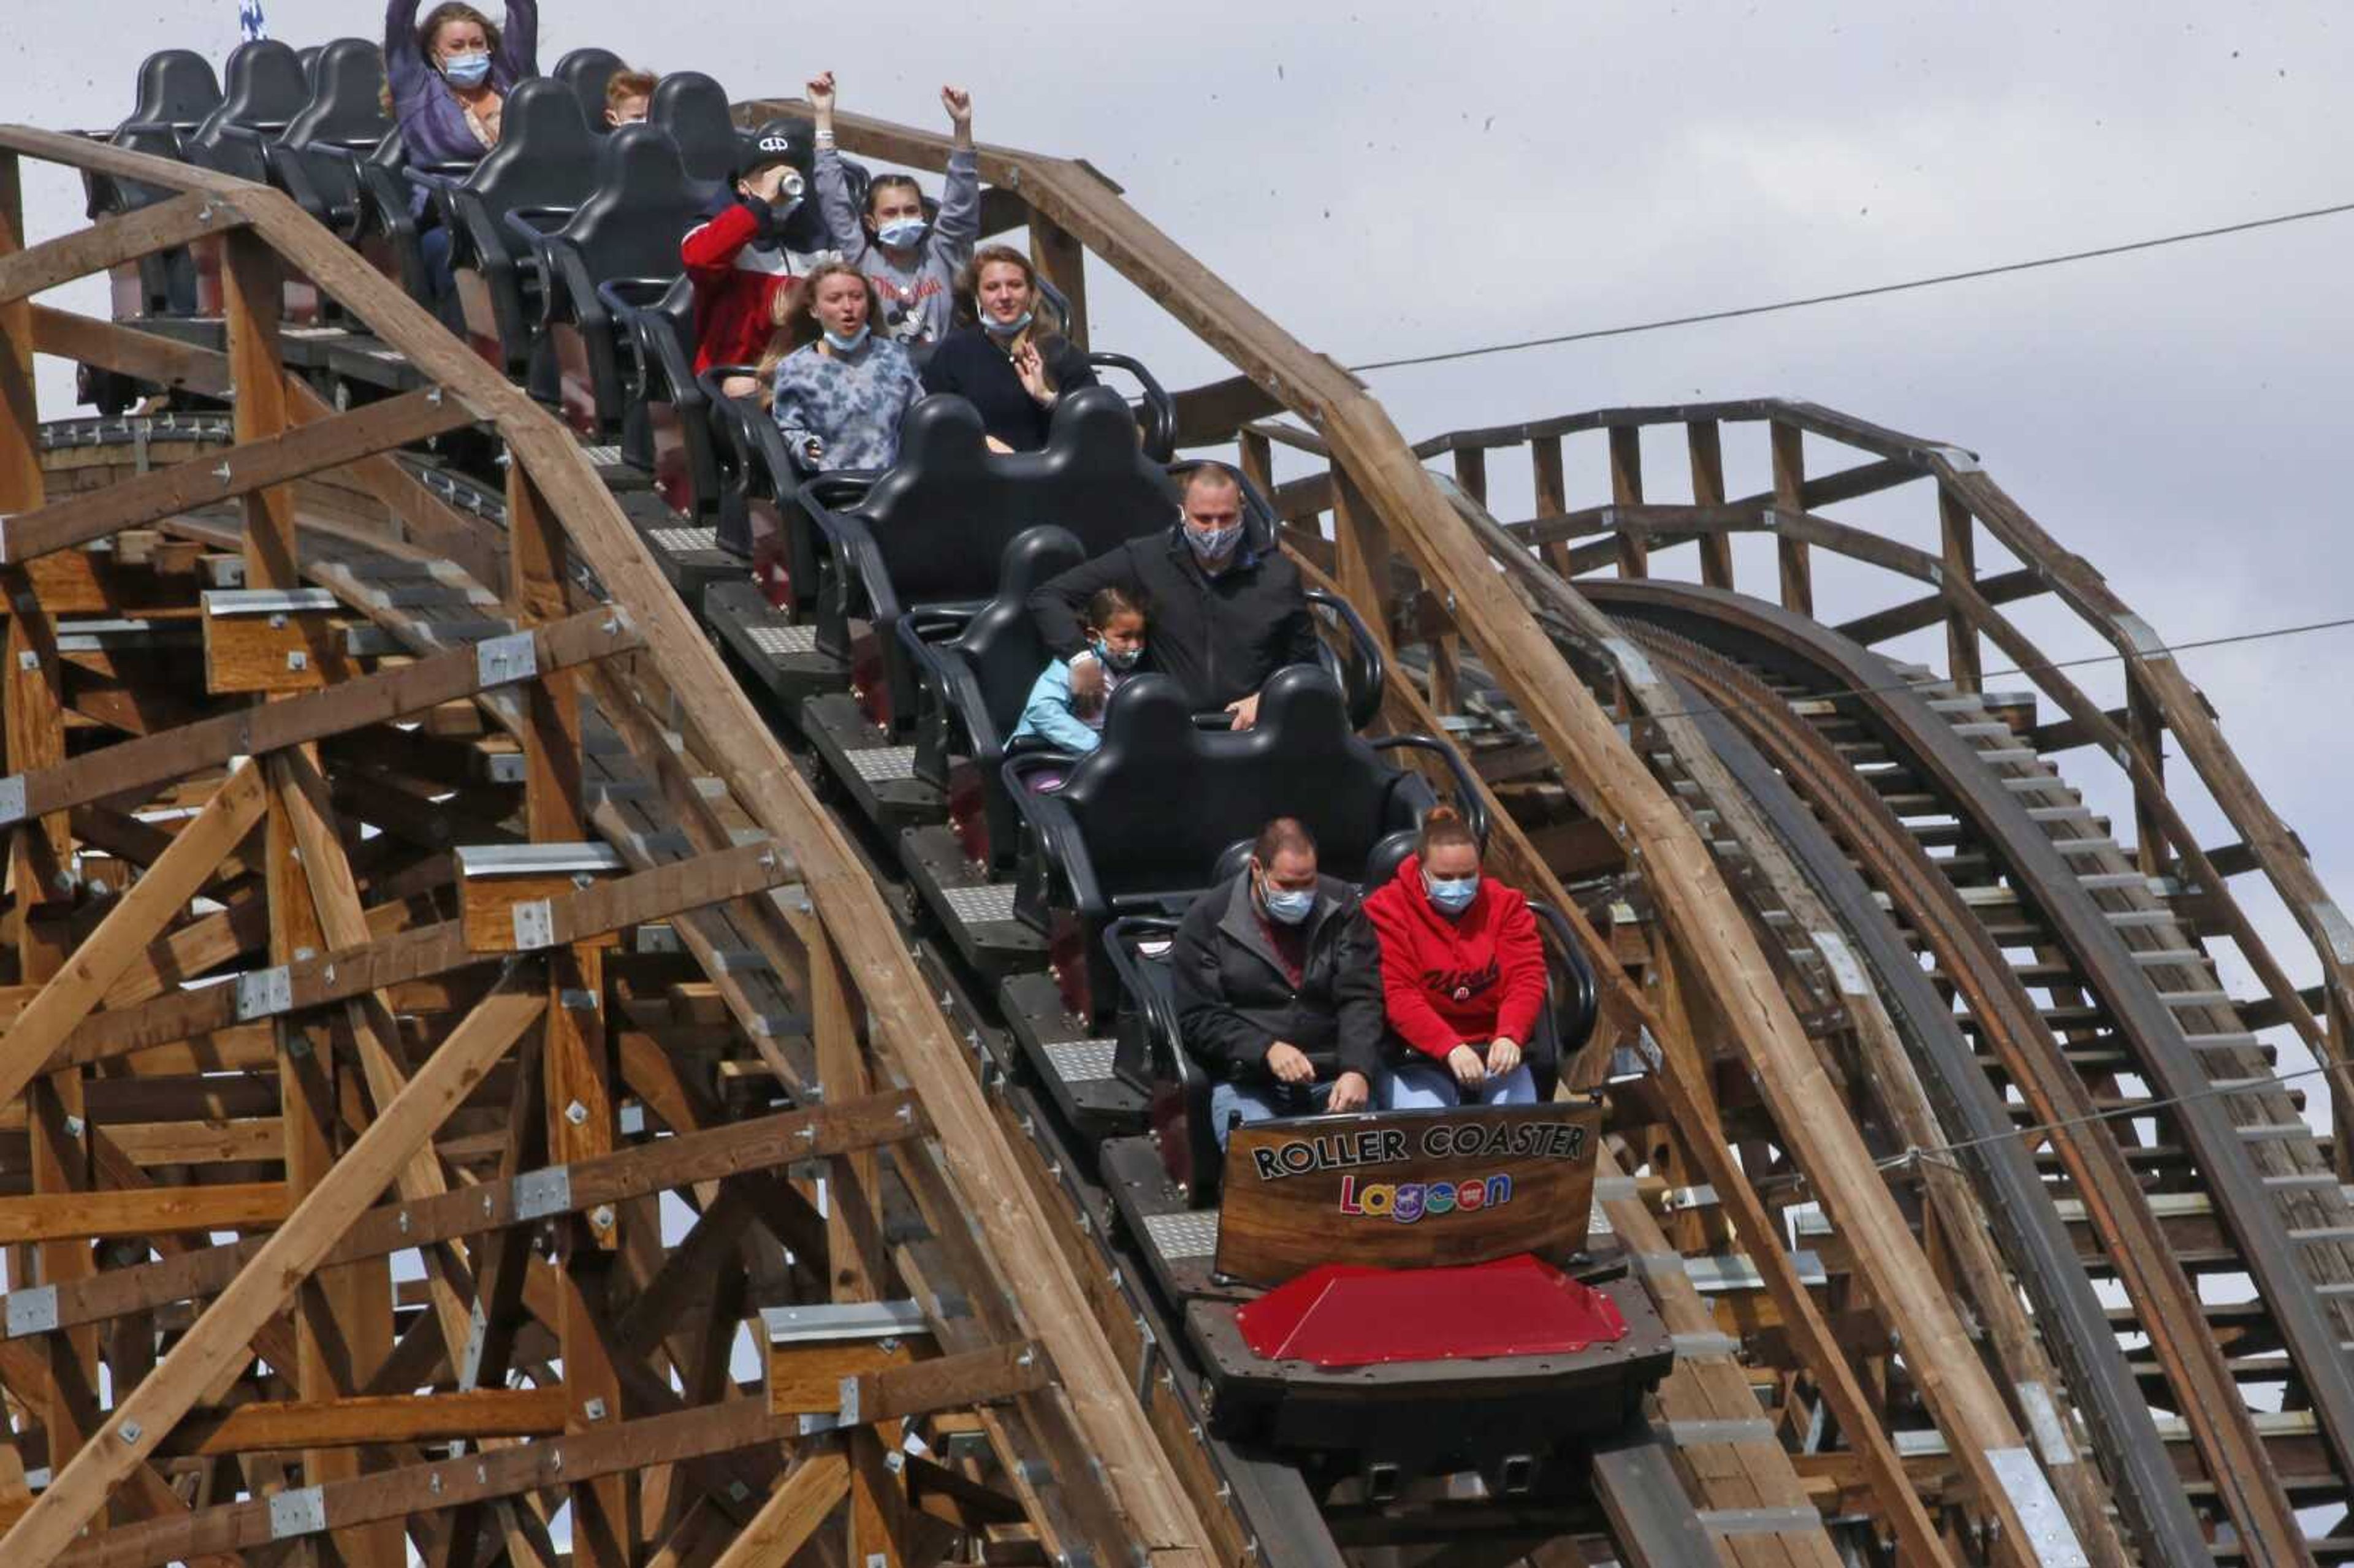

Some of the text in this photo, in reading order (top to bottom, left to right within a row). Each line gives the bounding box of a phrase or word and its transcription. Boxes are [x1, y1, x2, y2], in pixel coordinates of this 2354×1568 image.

[1252, 1122, 1585, 1181] ROLLER COASTER
[1340, 1174, 1512, 1223] Lagoon
